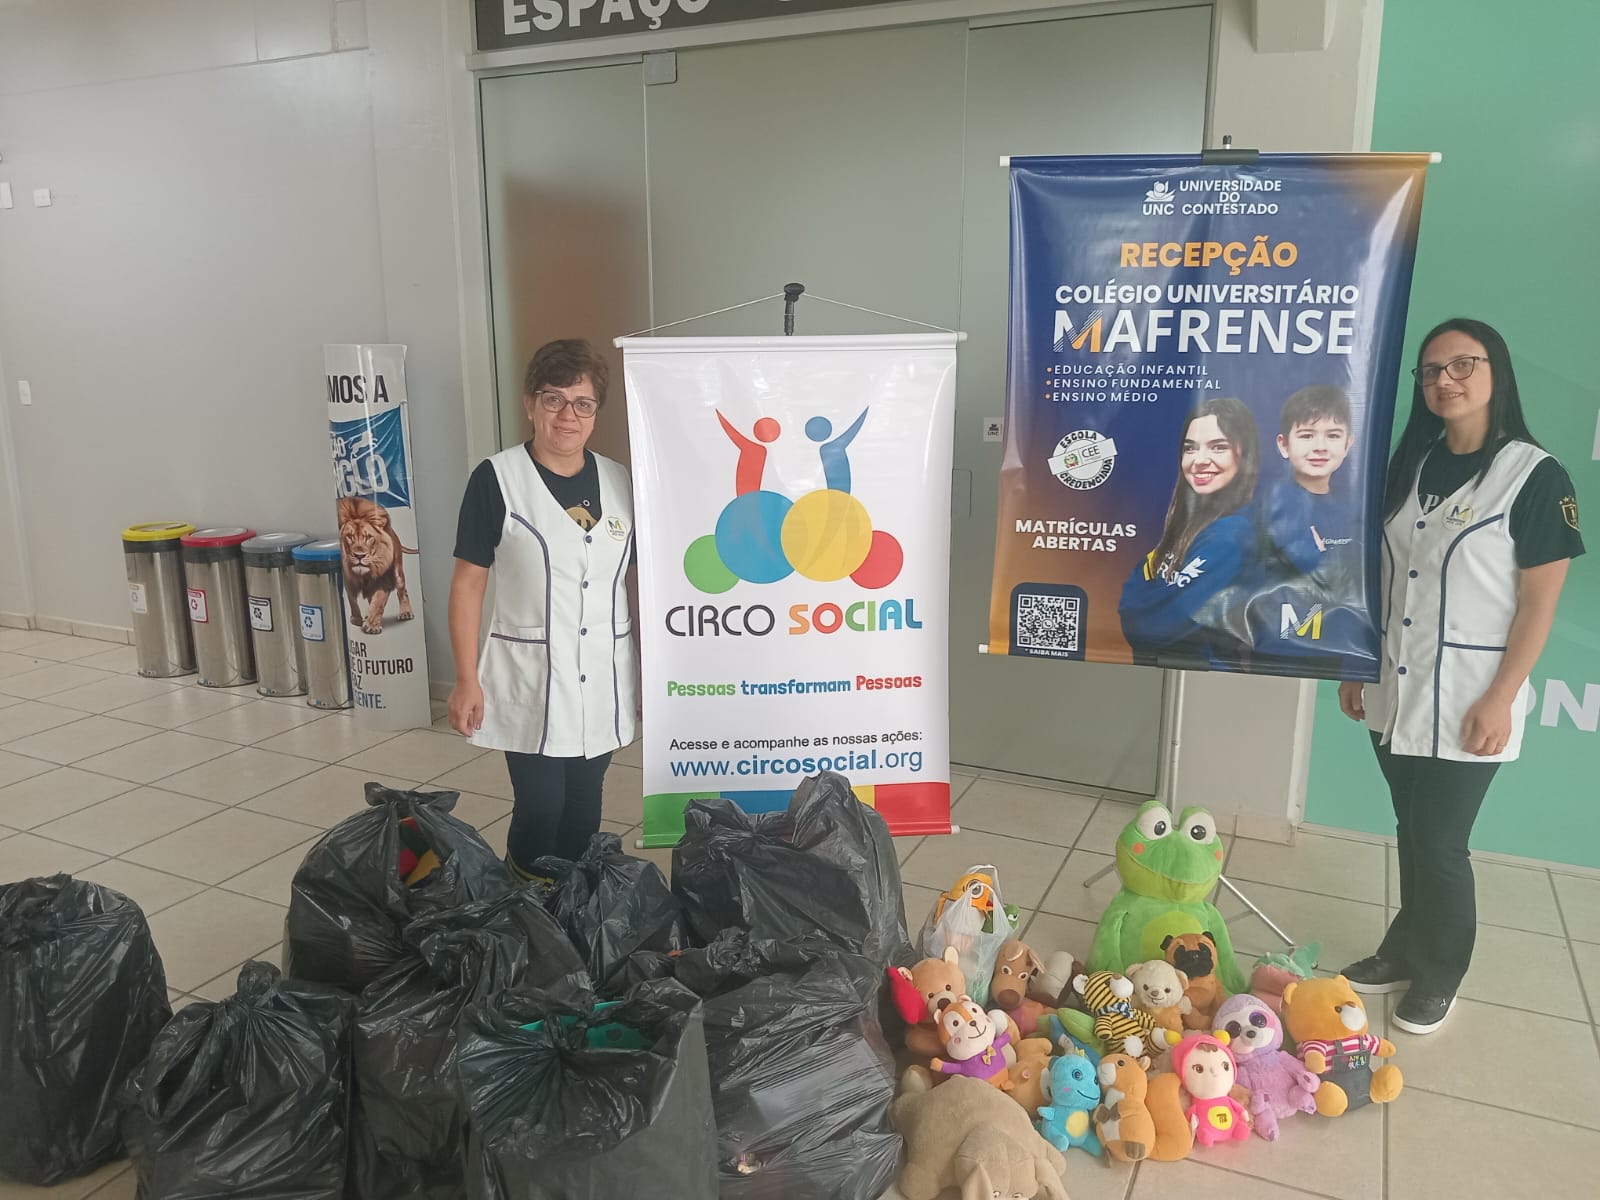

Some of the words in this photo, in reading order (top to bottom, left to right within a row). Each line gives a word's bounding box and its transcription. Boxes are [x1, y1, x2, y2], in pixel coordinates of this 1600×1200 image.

[503, 0, 711, 36] ESPAÇ
[1179, 179, 1282, 193] UNIVERSIDADE
[1219, 191, 1240, 203] DO
[1142, 203, 1175, 216] UNC
[1182, 203, 1279, 216] CONTESTADO
[1119, 235, 1298, 275] RECEPÇÃO
[1055, 279, 1162, 304] COLÉGIO
[1167, 279, 1359, 304] UNIVERSITÁRIO
[1053, 309, 1357, 354] MAFRENSE
[1054, 362, 1137, 378] EDUCAÇÃO
[1141, 364, 1209, 376] INFANTIL
[373, 374, 389, 403] A
[1053, 378, 1108, 389] ENSINO
[1111, 378, 1221, 391] FUNDAMENTAL
[1052, 391, 1107, 403] ENSINO
[1110, 389, 1158, 403] MÉDIO
[1060, 431, 1097, 449] ESCOLA
[1081, 445, 1101, 458] CEE
[1060, 458, 1113, 489] CREDENCIADA
[1015, 517, 1137, 538] MATRÍCULAS
[1032, 536, 1118, 553] ABERTAS
[665, 604, 776, 637] CIRCO
[788, 598, 923, 636] SOCIAL
[1029, 648, 1050, 656] SAIBA
[365, 657, 414, 676] FUTURO
[667, 680, 736, 697] Pessoas
[740, 678, 851, 696] transformam
[855, 674, 922, 691] Pessoas
[1526, 679, 1600, 733] N
[669, 738, 718, 751] Acesse
[721, 741, 729, 751] e
[733, 735, 809, 753] acompanhe
[813, 737, 829, 747] as
[832, 734, 878, 746] nossas
[881, 730, 923, 746] ações:
[670, 748, 923, 777] www.circosocial.org
